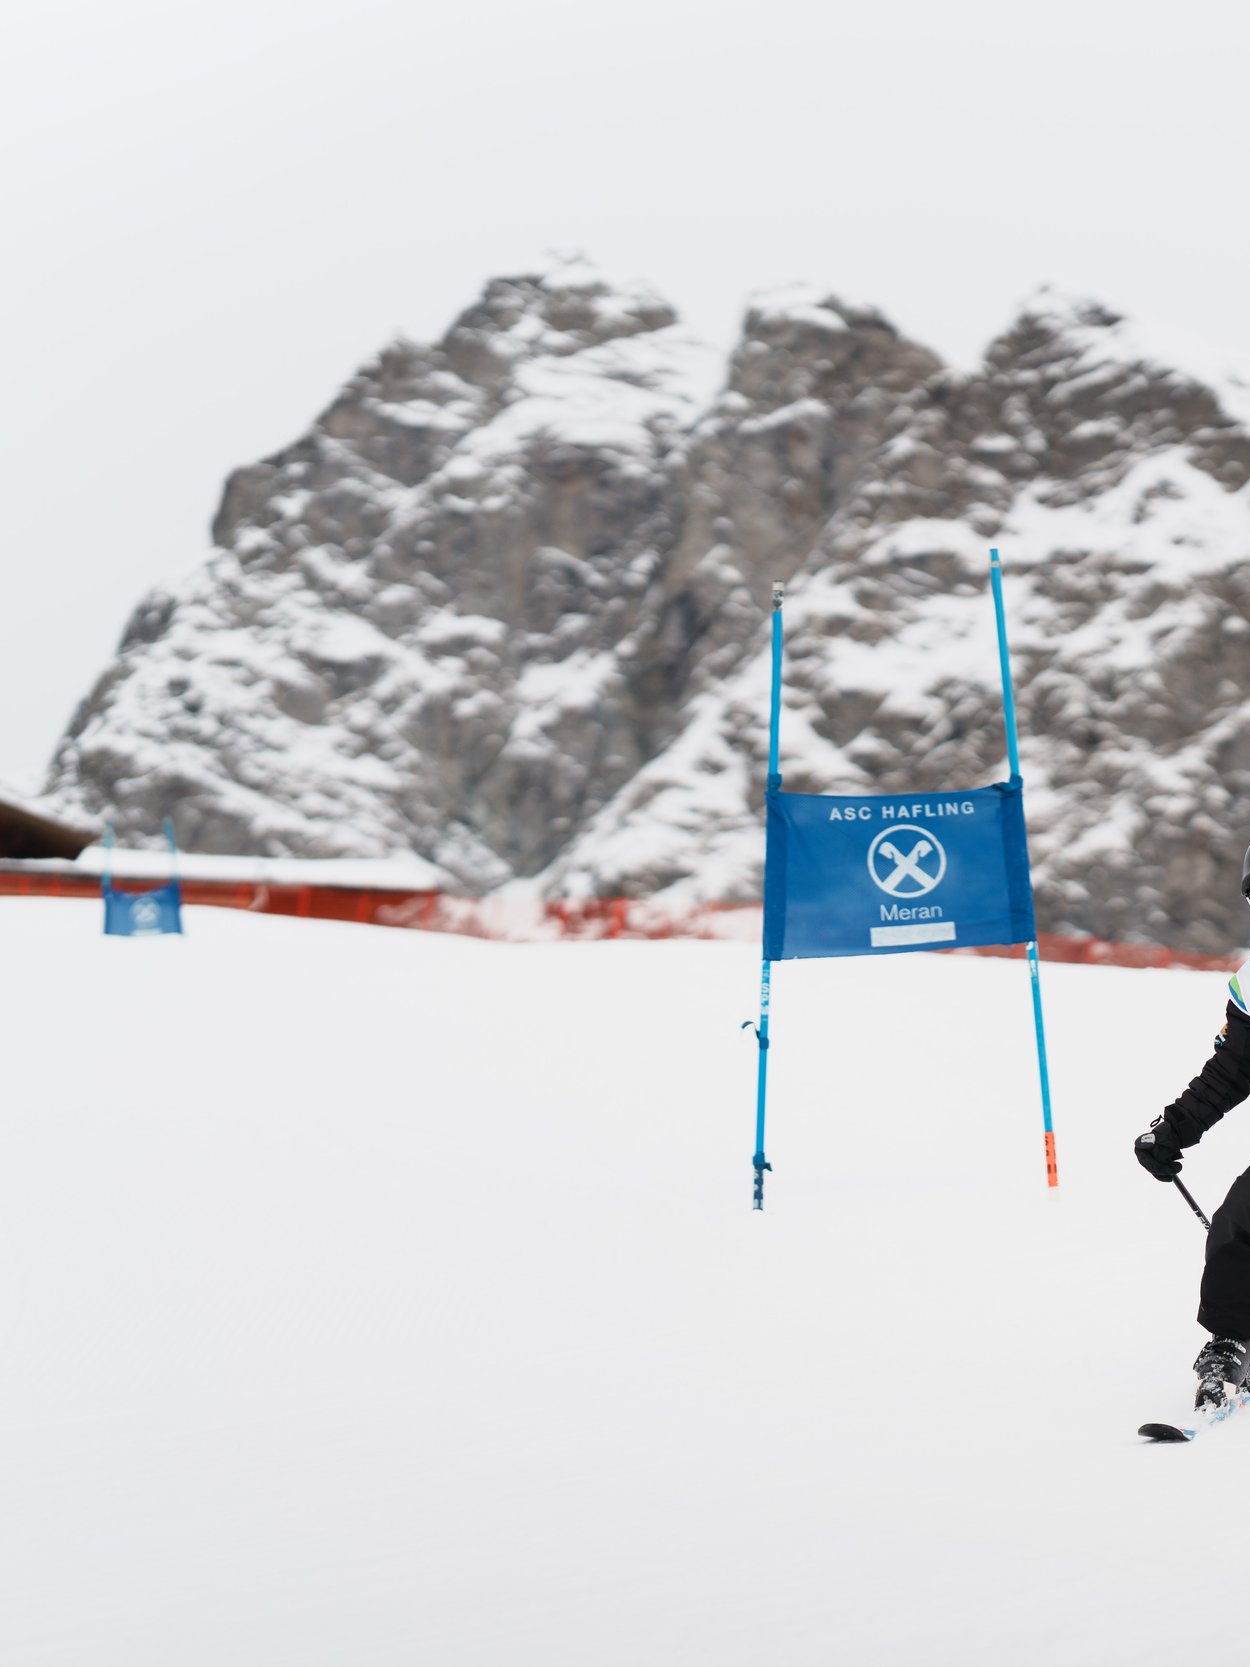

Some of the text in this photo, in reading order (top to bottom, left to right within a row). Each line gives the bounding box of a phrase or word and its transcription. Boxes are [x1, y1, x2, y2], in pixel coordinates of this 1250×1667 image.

[829, 801, 975, 821] ASC HAFLING
[879, 903, 943, 921] Meran
